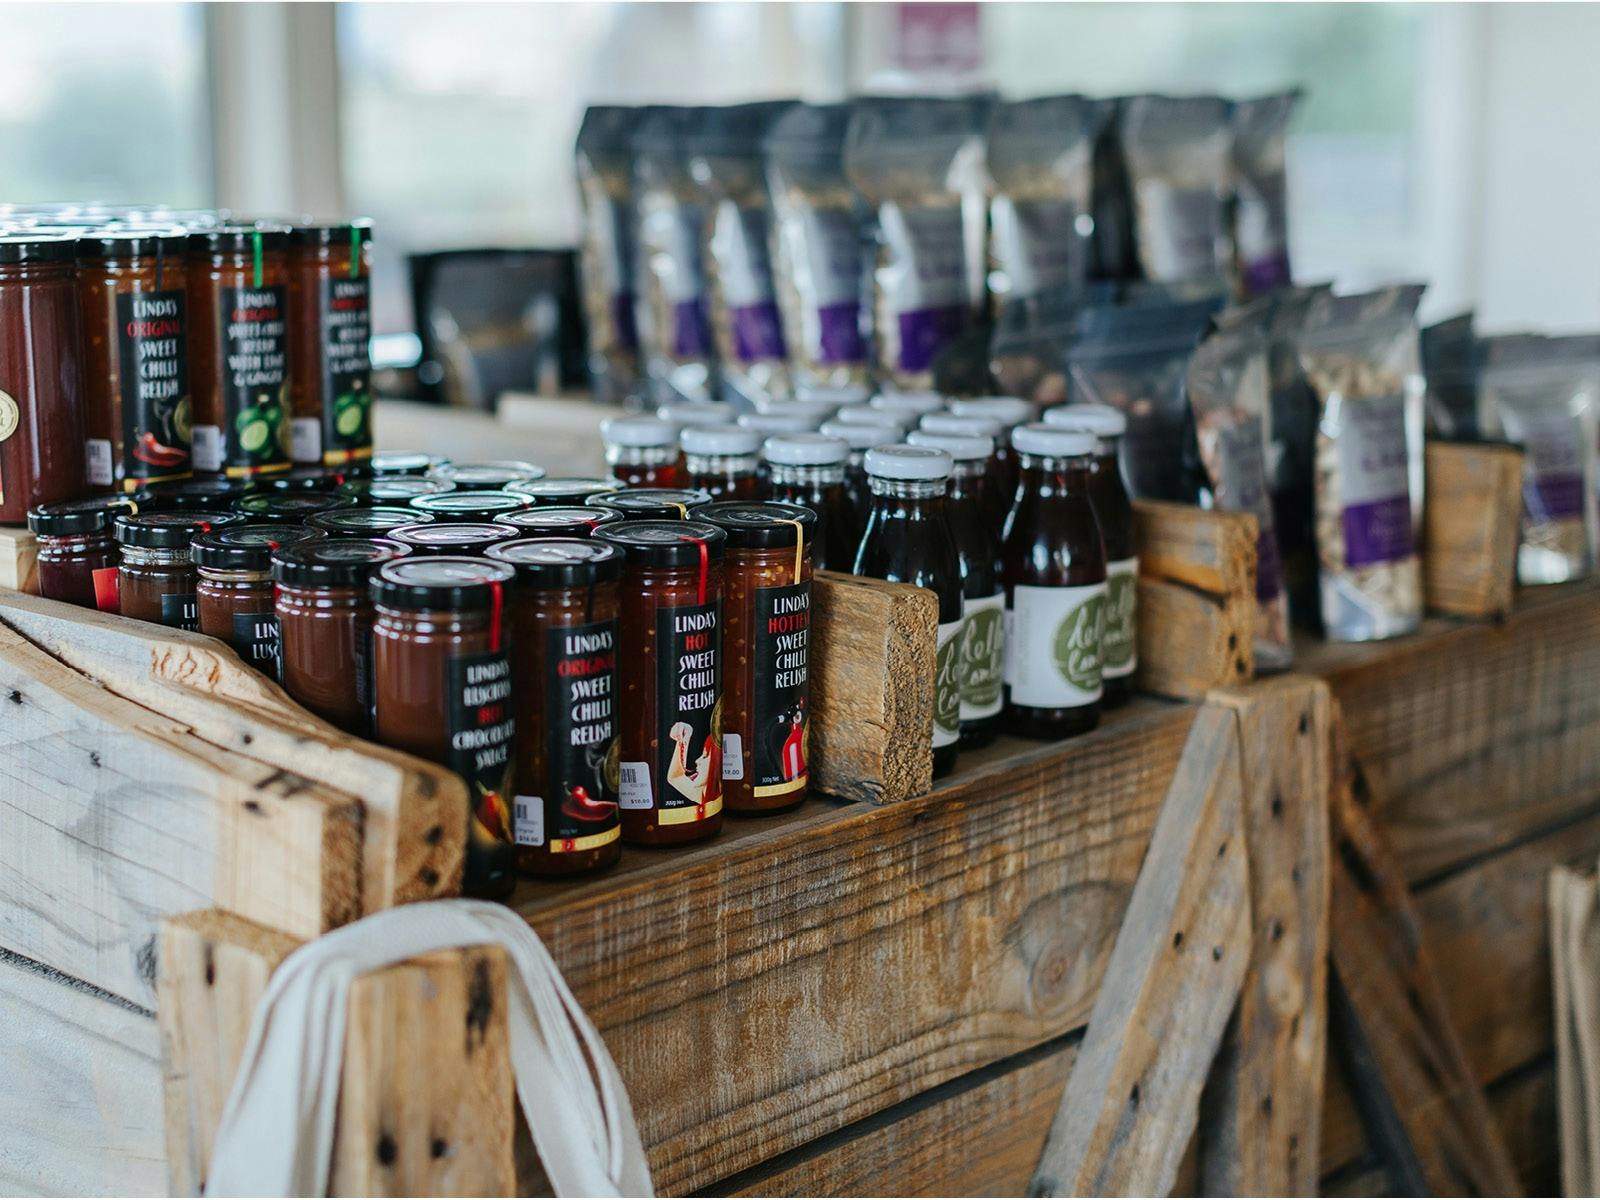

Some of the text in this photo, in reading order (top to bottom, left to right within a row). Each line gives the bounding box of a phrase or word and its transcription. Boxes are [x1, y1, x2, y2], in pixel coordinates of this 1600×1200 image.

[140, 339, 177, 359] SWEET
[140, 360, 177, 378] CHILLI
[140, 380, 178, 399] RELISH
[773, 592, 809, 615] LINDA'S
[675, 611, 716, 633] LINDA'S
[565, 631, 613, 655] LINDA'S
[685, 632, 709, 652] HOT
[775, 629, 807, 655] SWEET
[678, 649, 715, 673] SWEET
[775, 649, 807, 669] CHILLI
[571, 675, 611, 702] SWEET
[679, 669, 714, 690] CHILLI
[775, 667, 807, 689] RELISH
[571, 699, 611, 722] CHILLI
[679, 689, 715, 711] RELISH
[571, 721, 612, 746] RELISH
